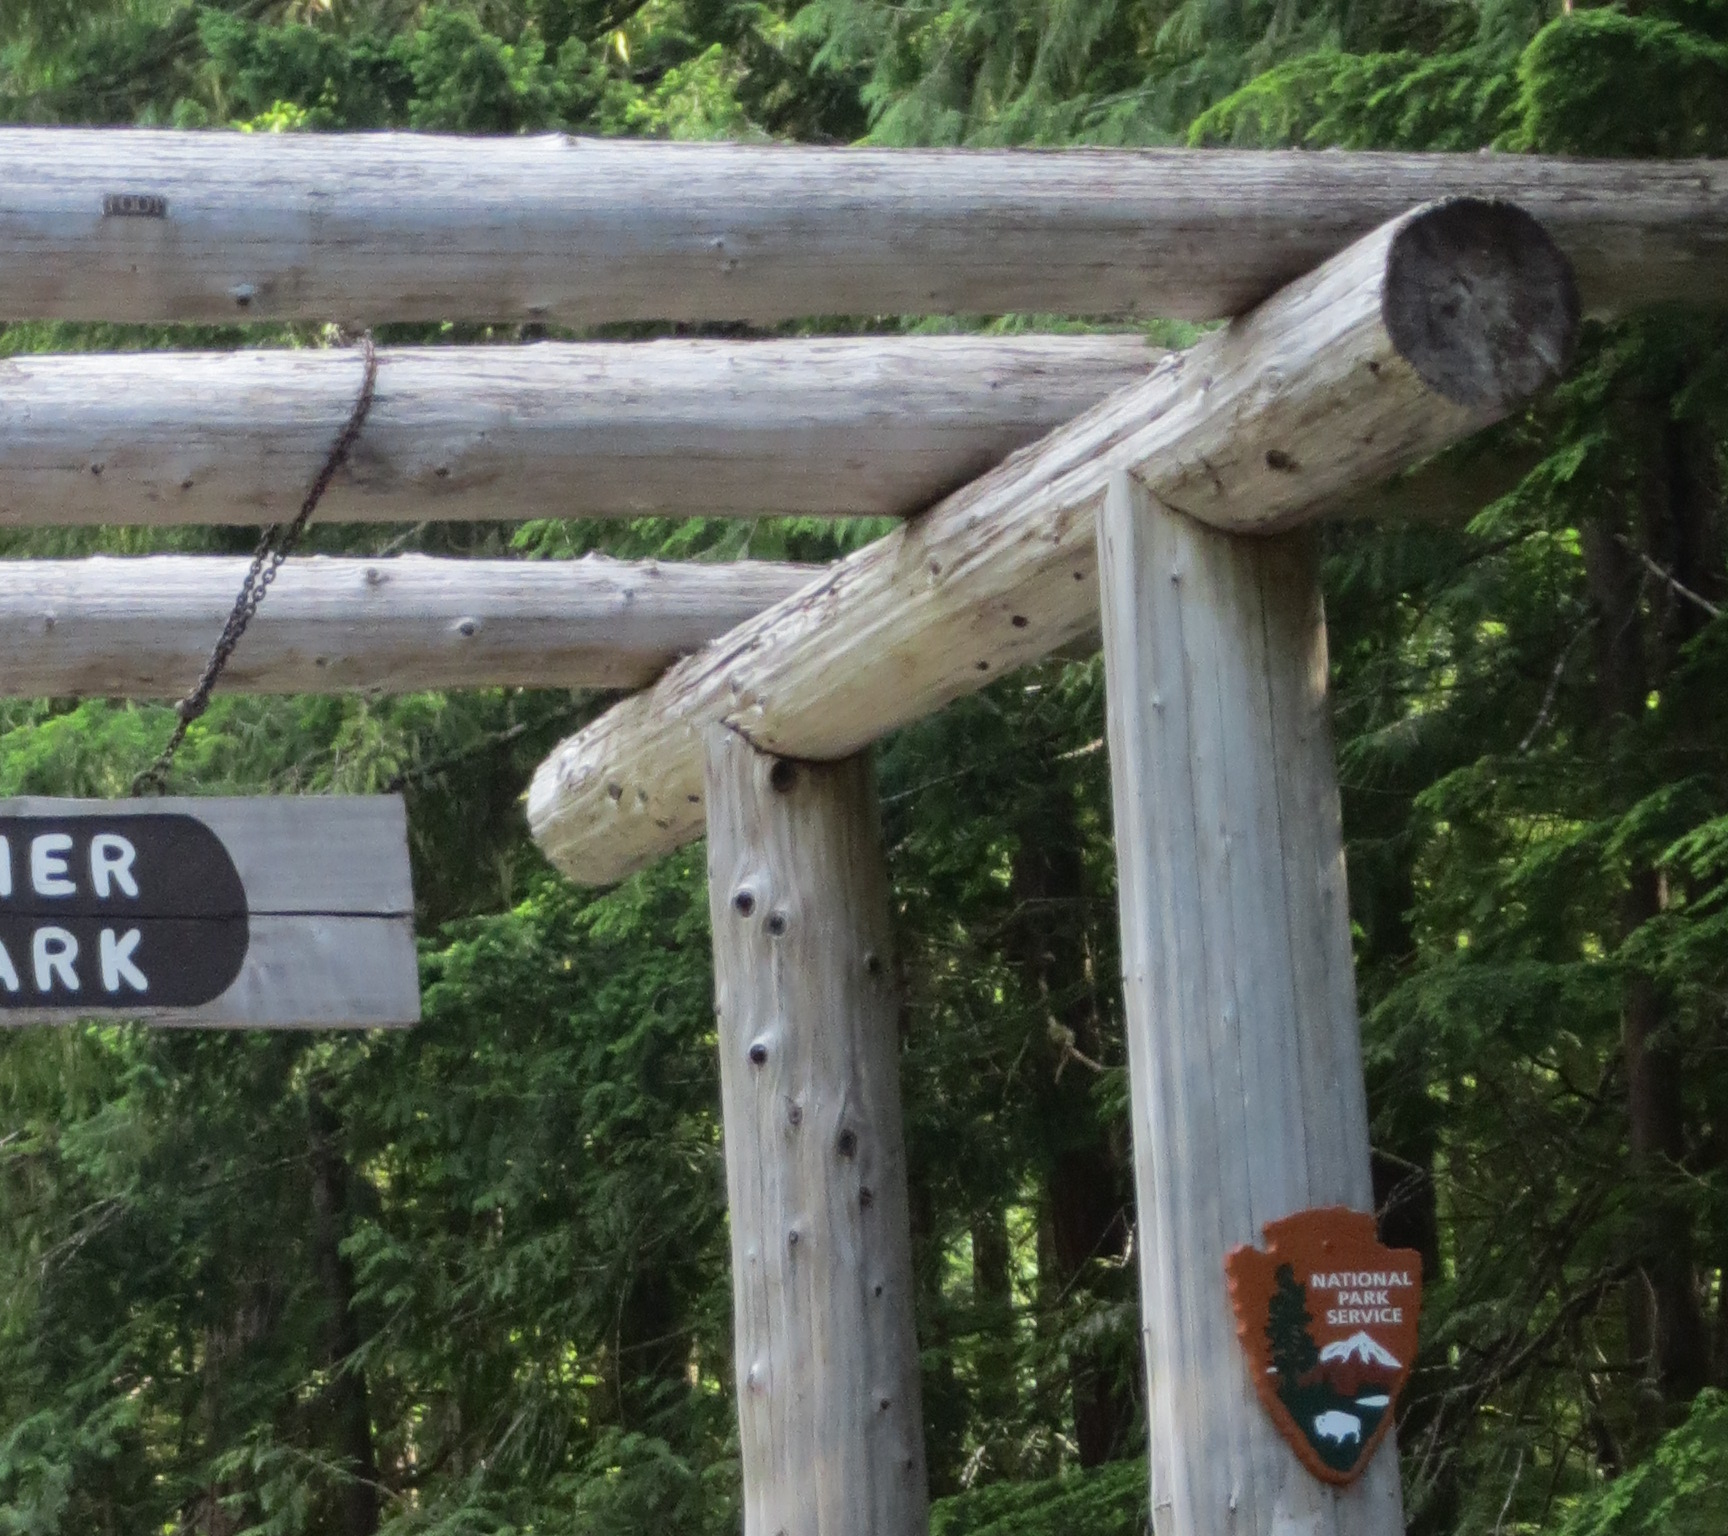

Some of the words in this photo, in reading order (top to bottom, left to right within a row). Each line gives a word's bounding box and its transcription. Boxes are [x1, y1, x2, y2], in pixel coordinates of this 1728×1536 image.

[1311, 1271, 1412, 1288] NATIONAL
[1338, 1290, 1390, 1305] PARK
[1327, 1308, 1403, 1324] SERVICE
